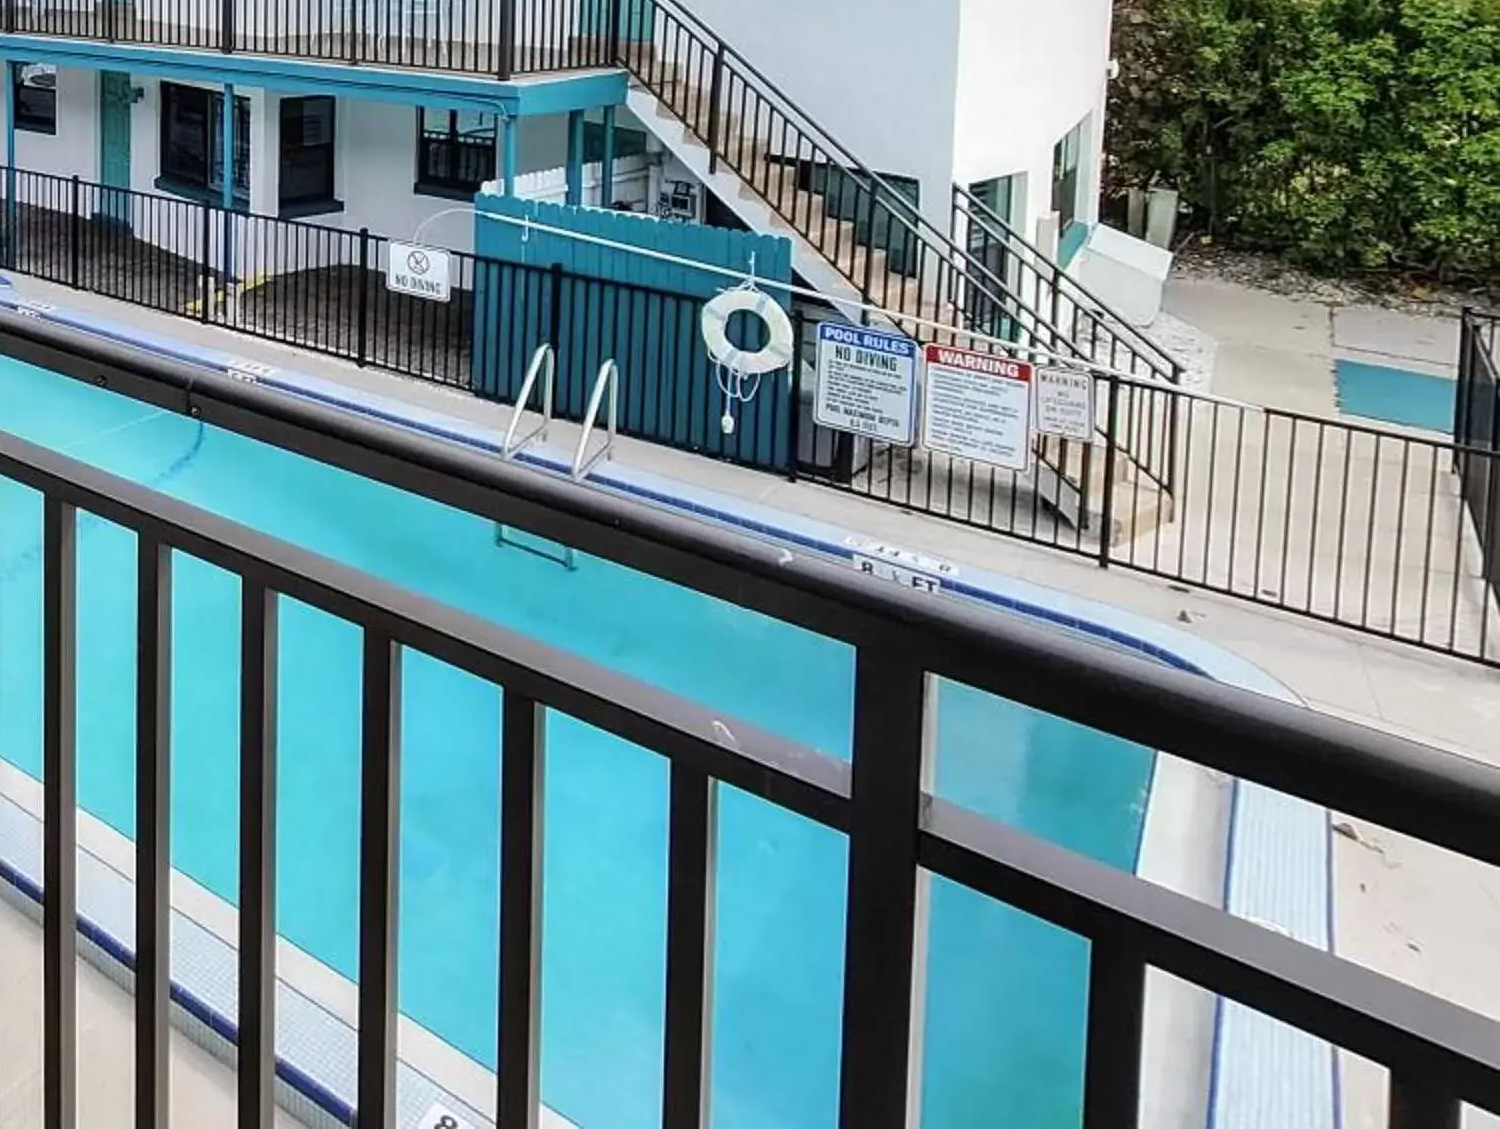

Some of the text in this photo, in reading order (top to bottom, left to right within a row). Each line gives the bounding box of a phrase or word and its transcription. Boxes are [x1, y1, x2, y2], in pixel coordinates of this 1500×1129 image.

[395, 273, 442, 295] NO DIVING
[825, 327, 909, 355] POOL RULES
[835, 345, 851, 361] NO
[856, 350, 898, 372] DIVING
[938, 349, 1020, 378] WARNING
[1041, 374, 1087, 391] WARNING
[911, 576, 937, 592] FT
